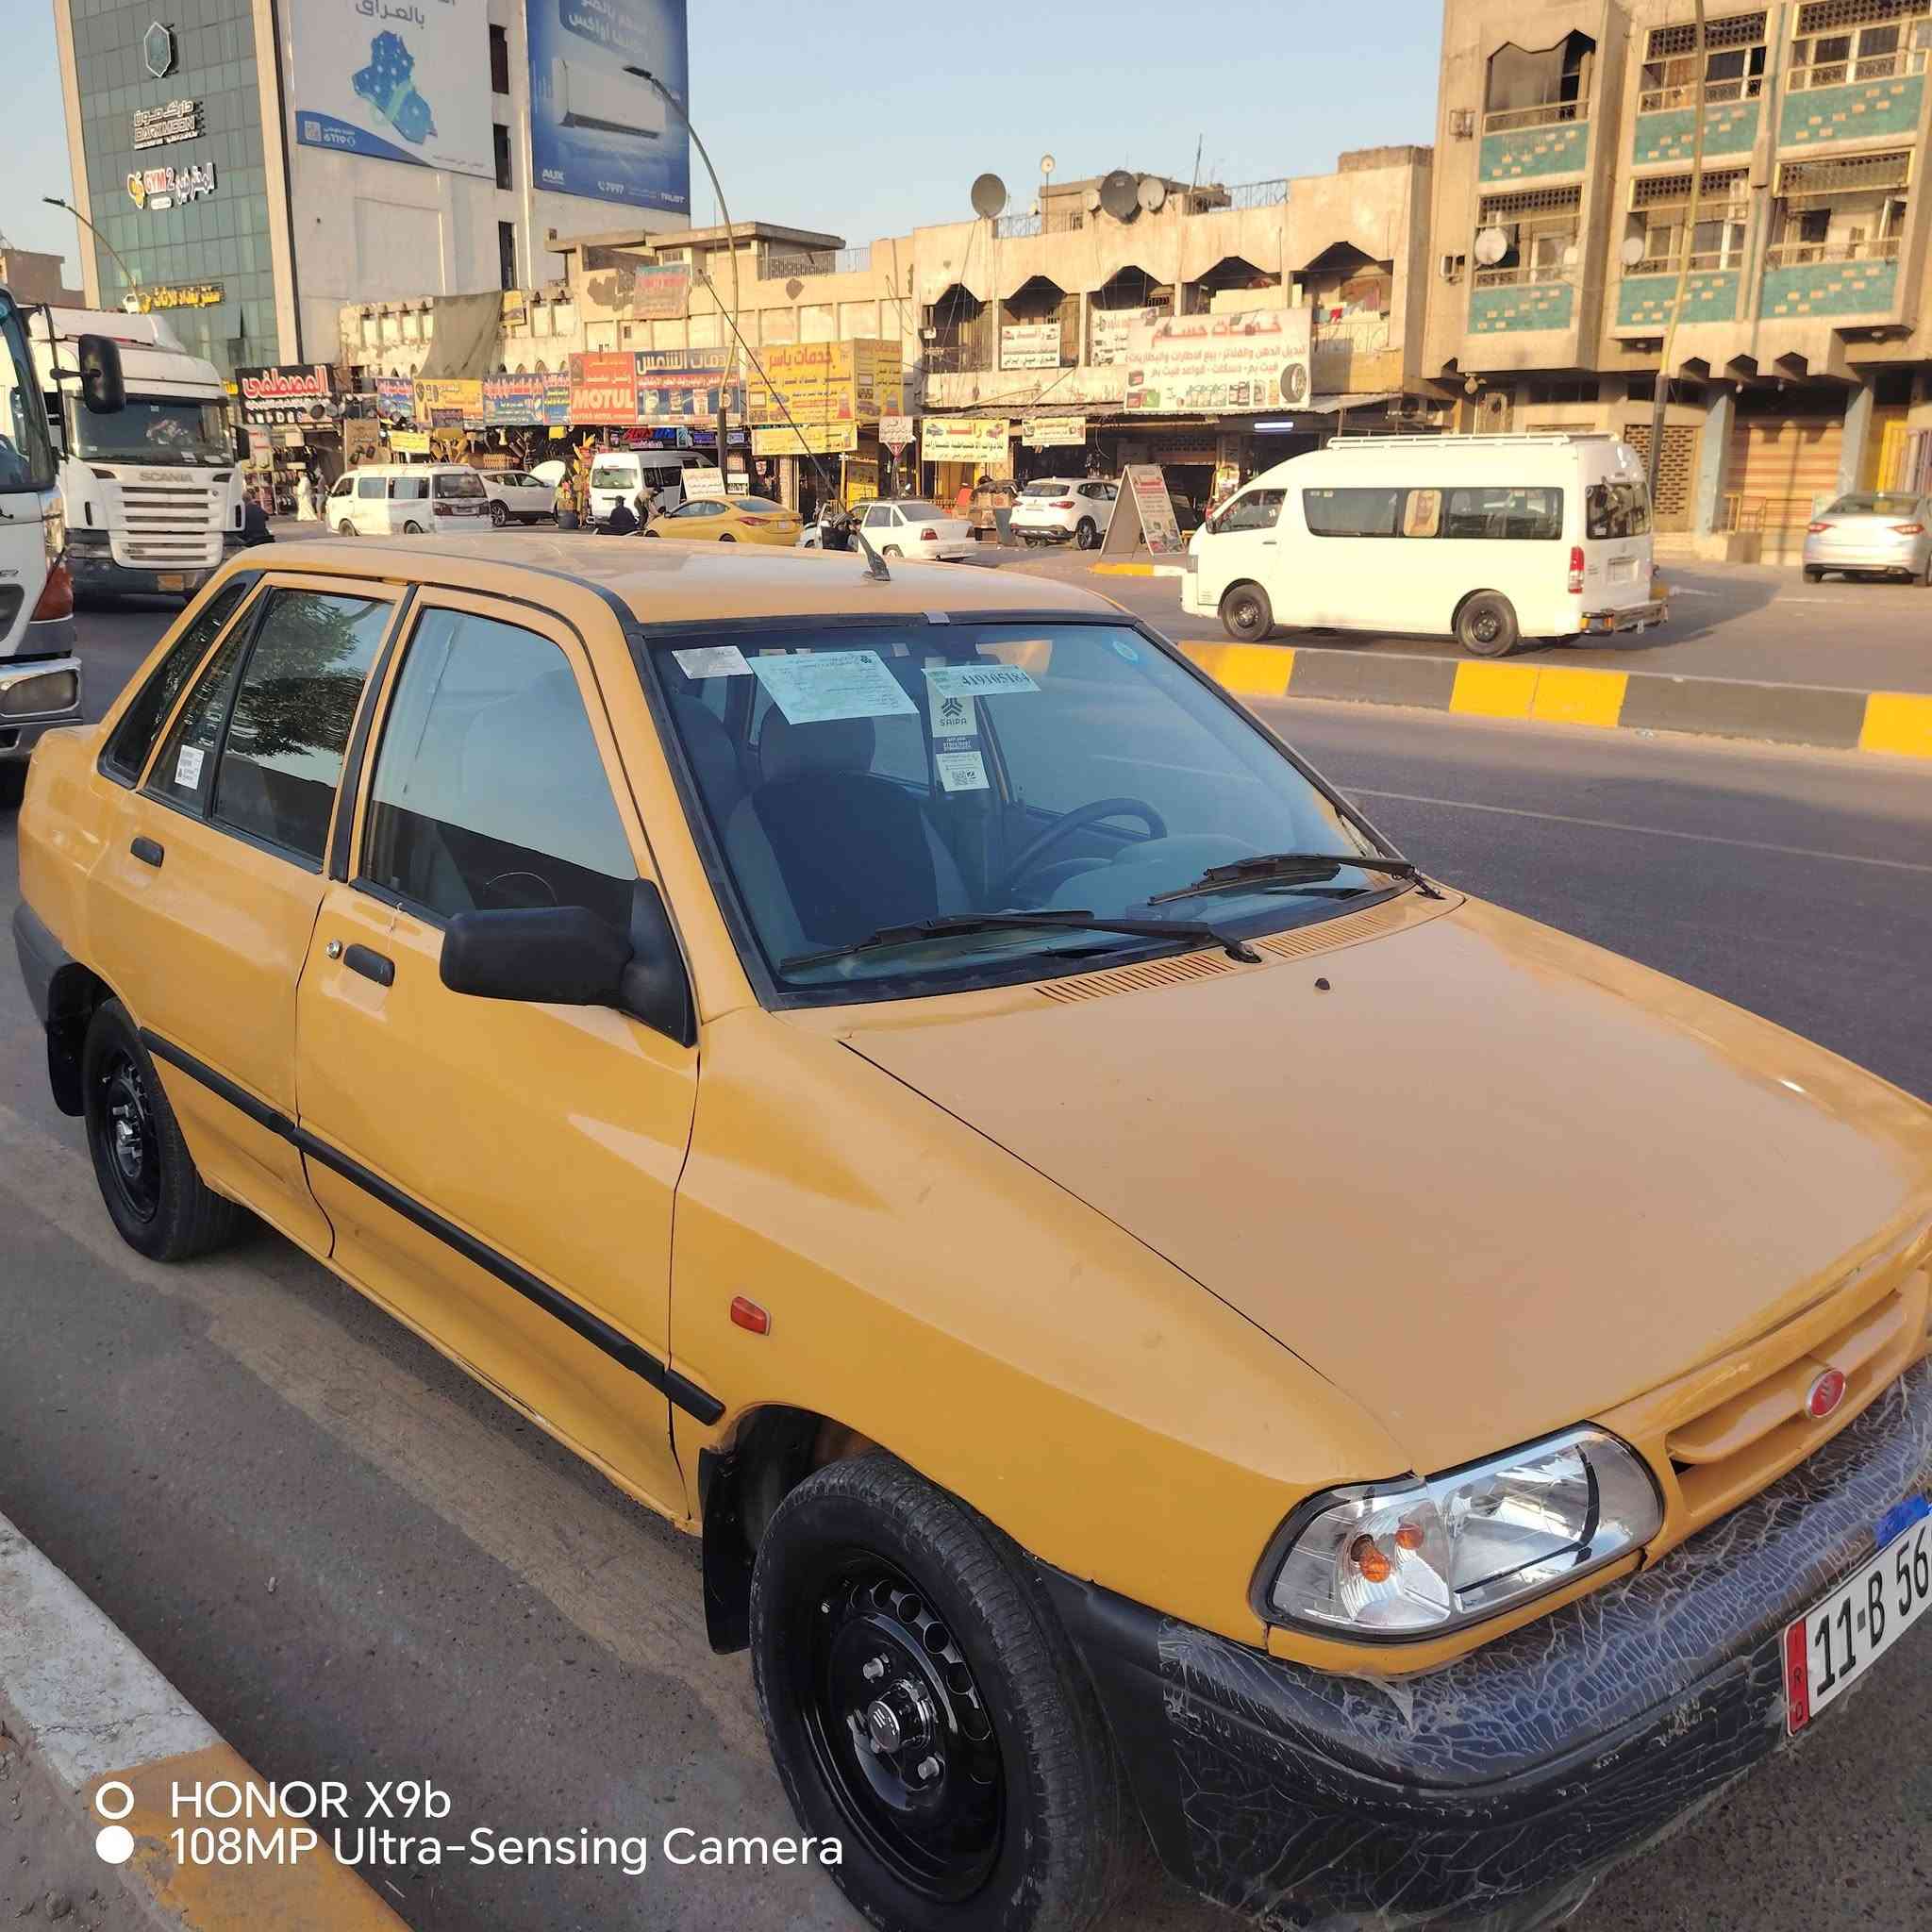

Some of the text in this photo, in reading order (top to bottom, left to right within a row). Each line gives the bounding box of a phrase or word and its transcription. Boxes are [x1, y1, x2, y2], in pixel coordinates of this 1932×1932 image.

[242, 364, 329, 399] المصطفى
[573, 388, 635, 409] MOTUL
[139, 472, 196, 484] SCANIA
[940, 717, 967, 726] SAIPA
